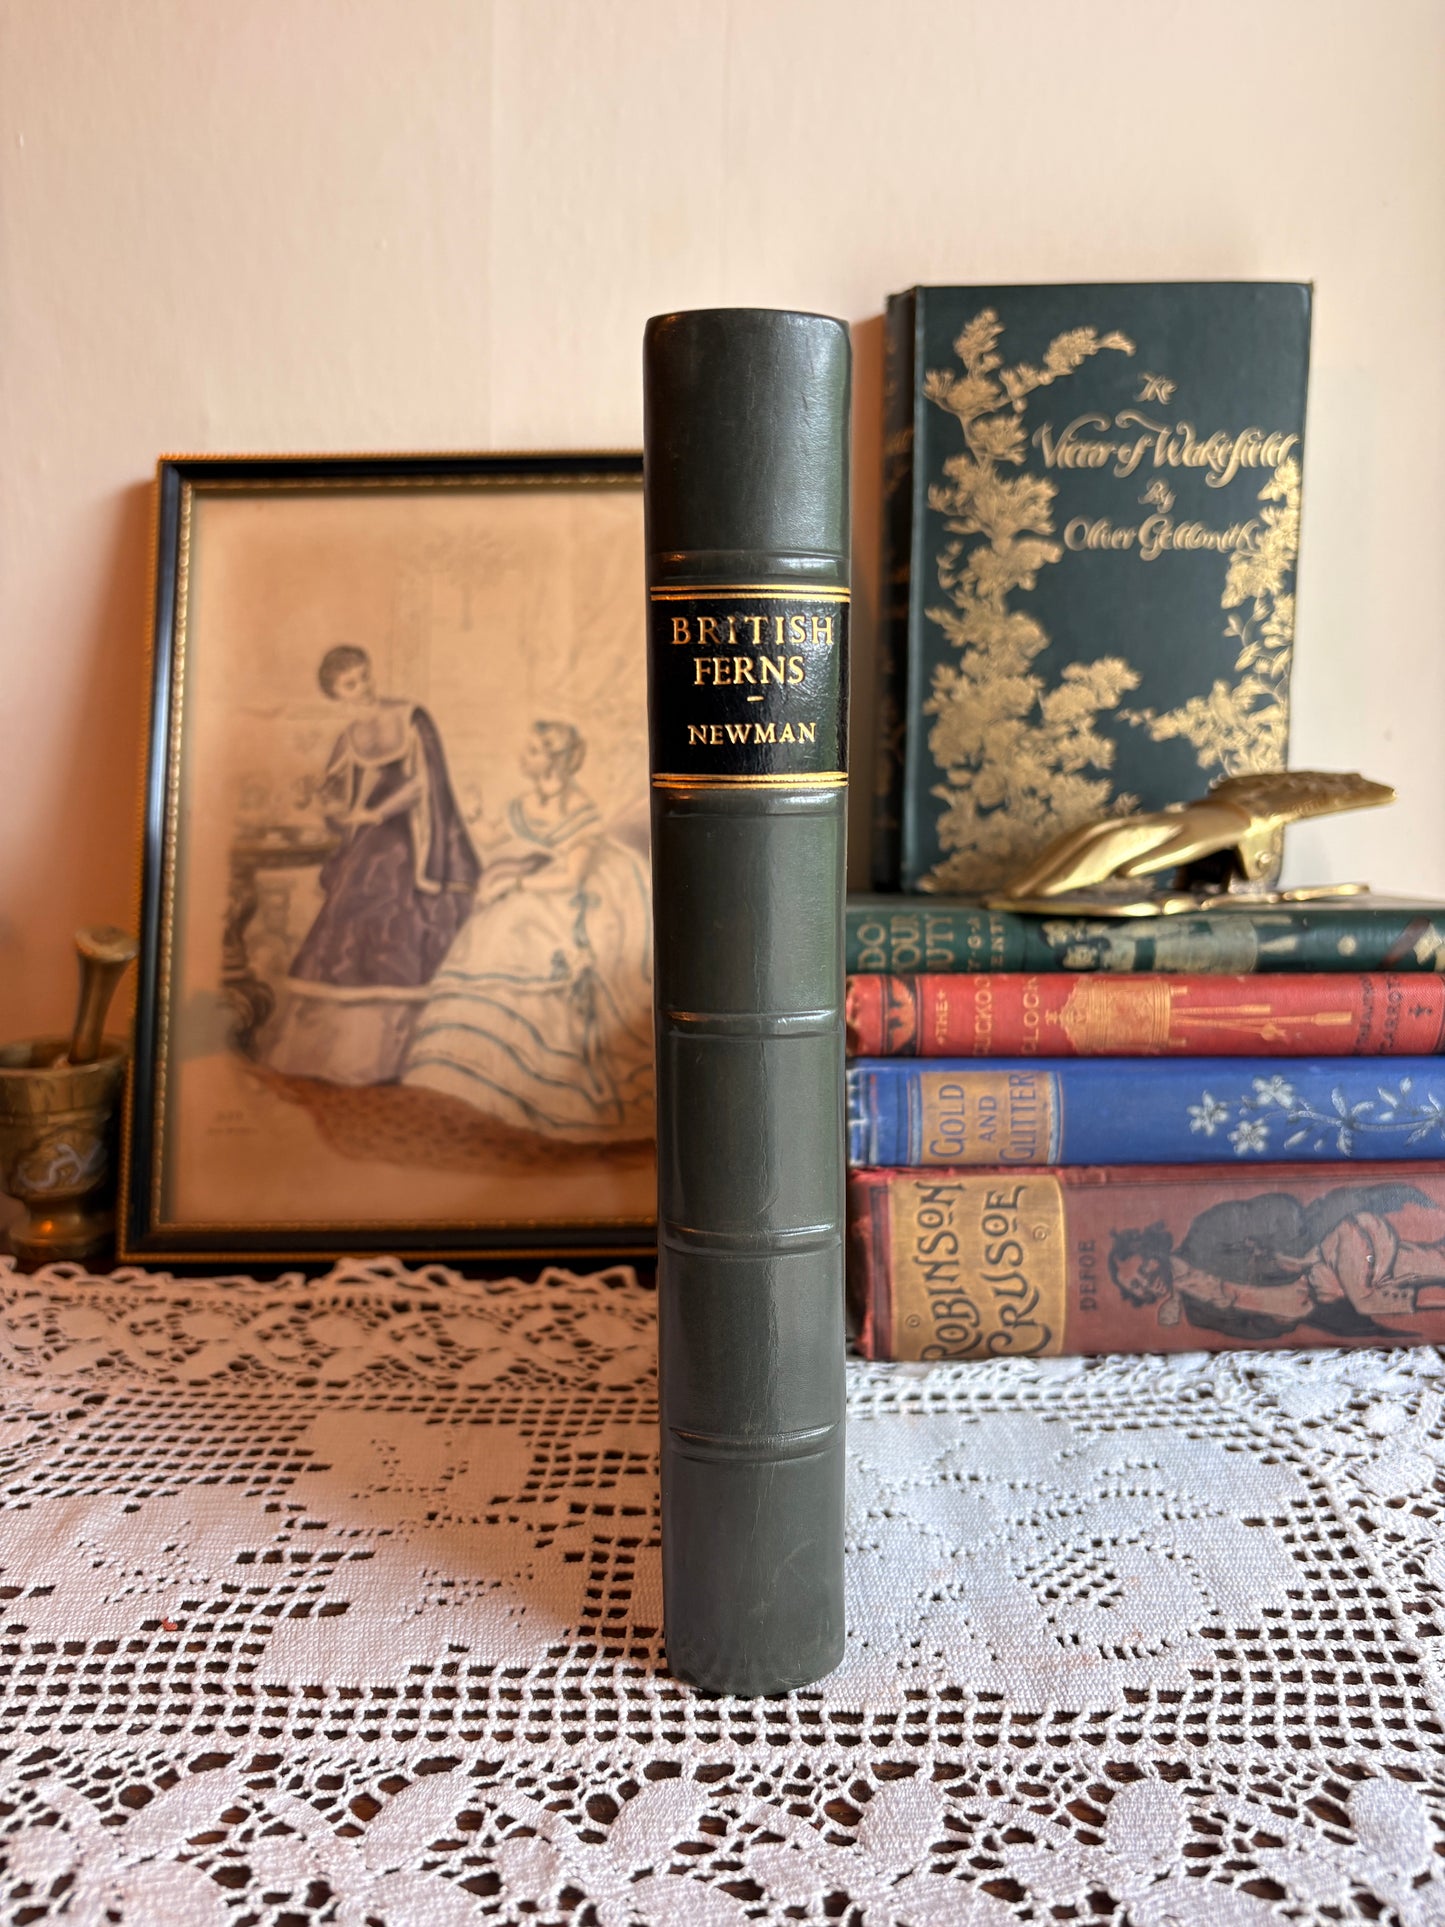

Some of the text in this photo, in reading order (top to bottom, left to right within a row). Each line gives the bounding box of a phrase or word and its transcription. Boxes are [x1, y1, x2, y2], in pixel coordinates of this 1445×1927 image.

[671, 615, 835, 646] BRITISH
[693, 655, 806, 686] FERNS
[687, 722, 817, 745] NEWMAN
[857, 921, 886, 970] DO
[929, 1083, 965, 1158] GOLD
[978, 1095, 997, 1142] AND
[998, 1072, 1037, 1164] GLITTER
[914, 1181, 983, 1361] ROBINSON
[980, 1184, 1051, 1357] CRUSOE
[1078, 1239, 1096, 1312] DEFOE
